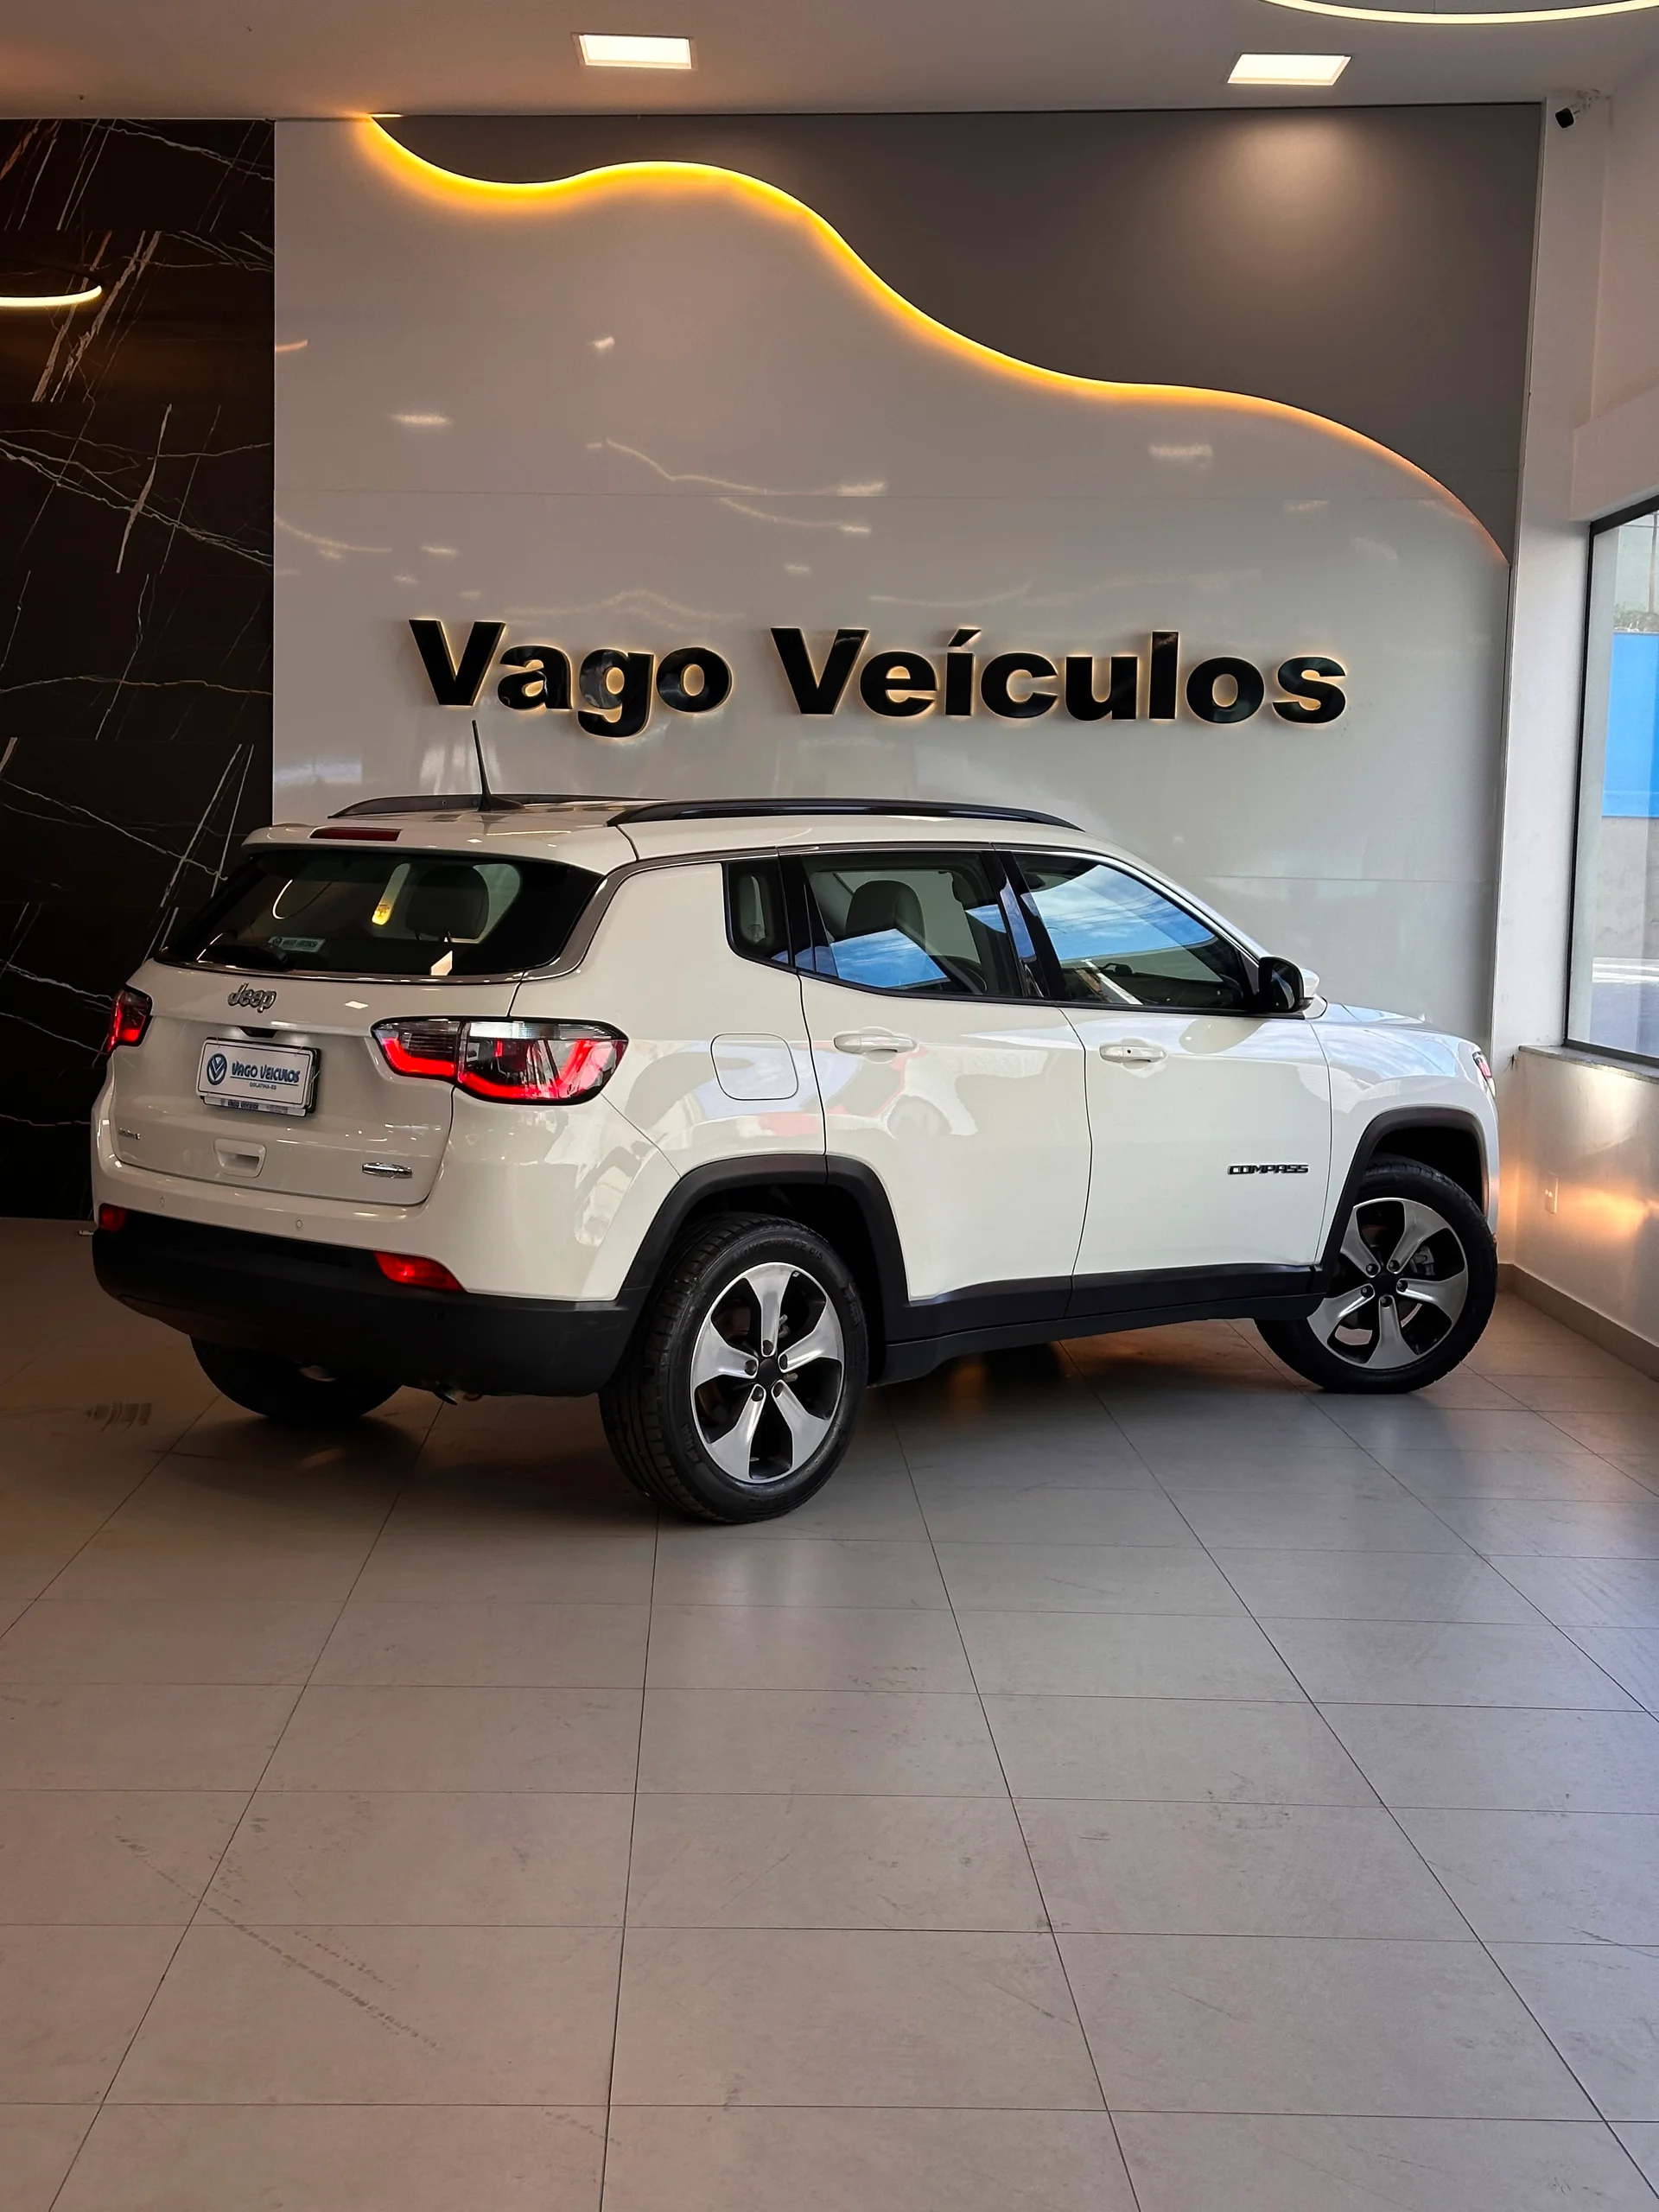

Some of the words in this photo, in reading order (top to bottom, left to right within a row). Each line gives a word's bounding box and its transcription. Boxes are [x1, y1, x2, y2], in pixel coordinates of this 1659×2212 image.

[409, 619, 733, 739] Vago
[770, 626, 1347, 725] Veículos
[227, 982, 276, 1014] Jeep
[232, 1061, 258, 1077] VAGO
[1228, 1164, 1309, 1175] COMPASS
